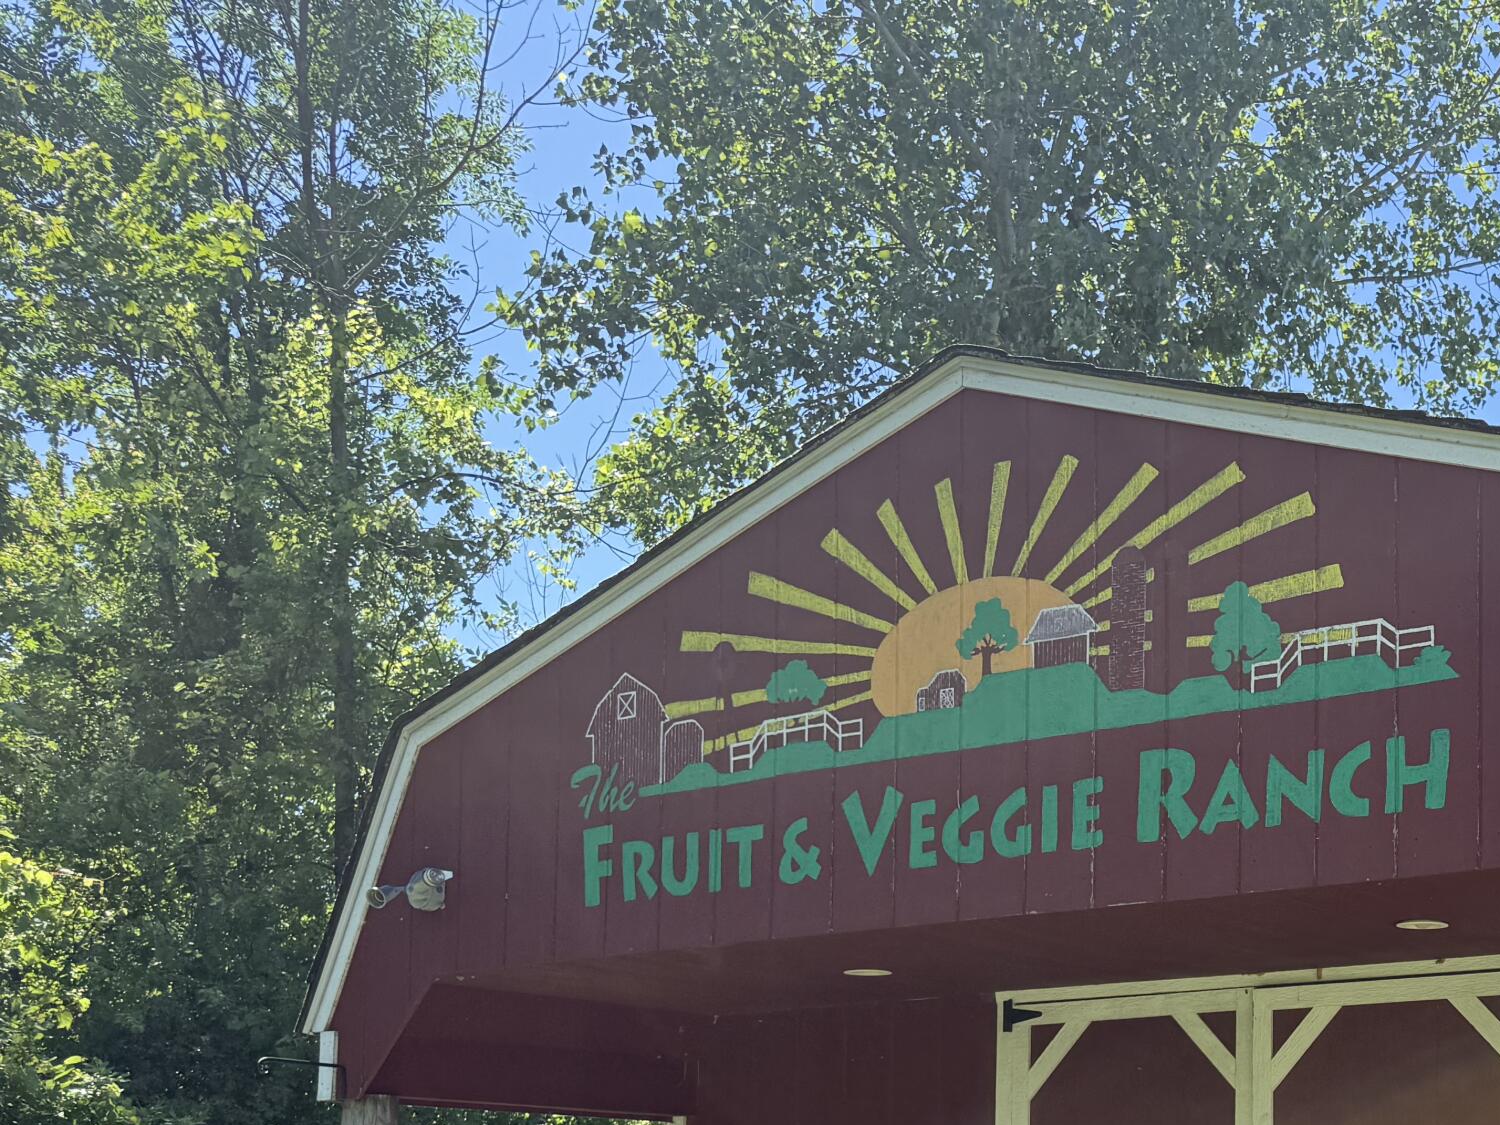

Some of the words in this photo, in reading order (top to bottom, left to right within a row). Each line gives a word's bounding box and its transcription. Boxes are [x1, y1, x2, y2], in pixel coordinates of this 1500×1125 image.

[570, 762, 636, 819] The
[582, 823, 764, 908] FRUIT
[778, 816, 822, 885] &
[841, 776, 1104, 877] VEGGIE
[1136, 728, 1451, 843] RANCH
